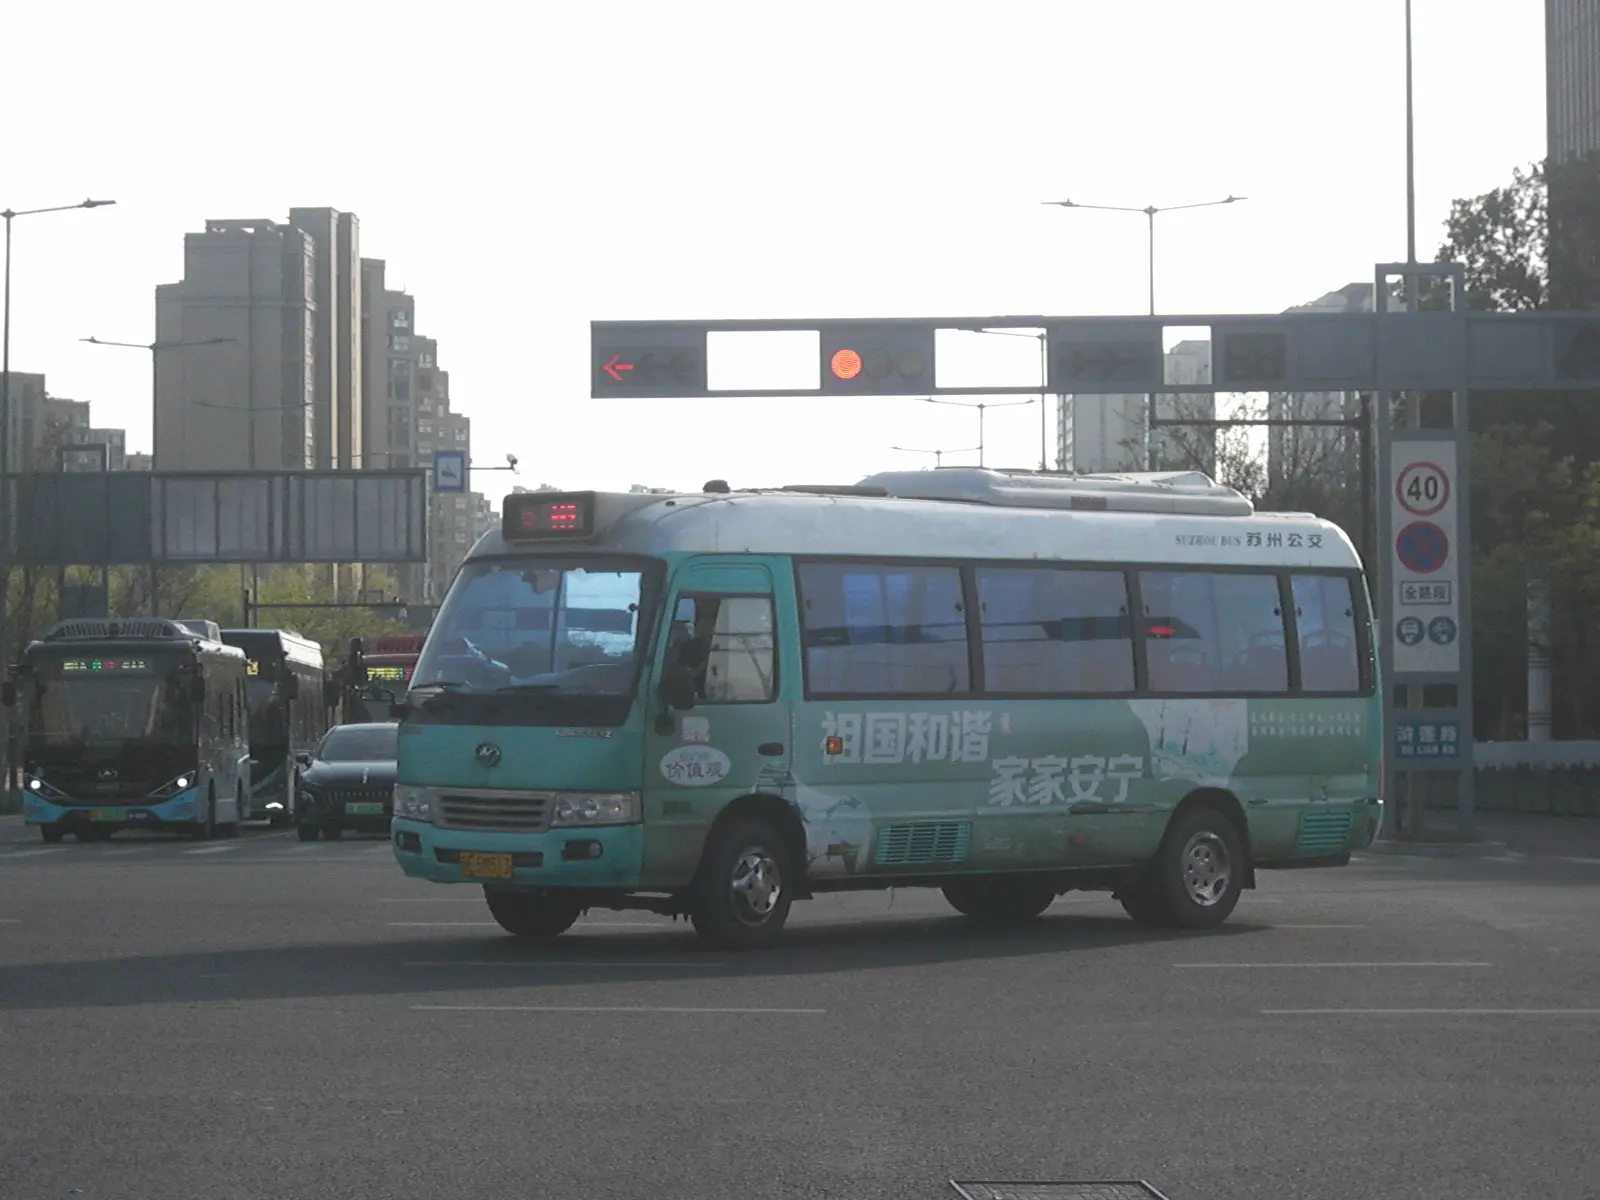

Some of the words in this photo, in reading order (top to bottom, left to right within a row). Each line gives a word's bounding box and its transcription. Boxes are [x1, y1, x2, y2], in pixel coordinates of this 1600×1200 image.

[1407, 475, 1439, 501] 40
[1175, 534, 1217, 546] SUZHOU
[1220, 535, 1242, 546] BUS
[1246, 531, 1324, 549] 苏州公交
[1404, 585, 1447, 600] 全路段
[819, 709, 993, 766] 祖国和谐
[664, 761, 724, 780] 价值观
[987, 753, 1146, 807] 家家安宁
